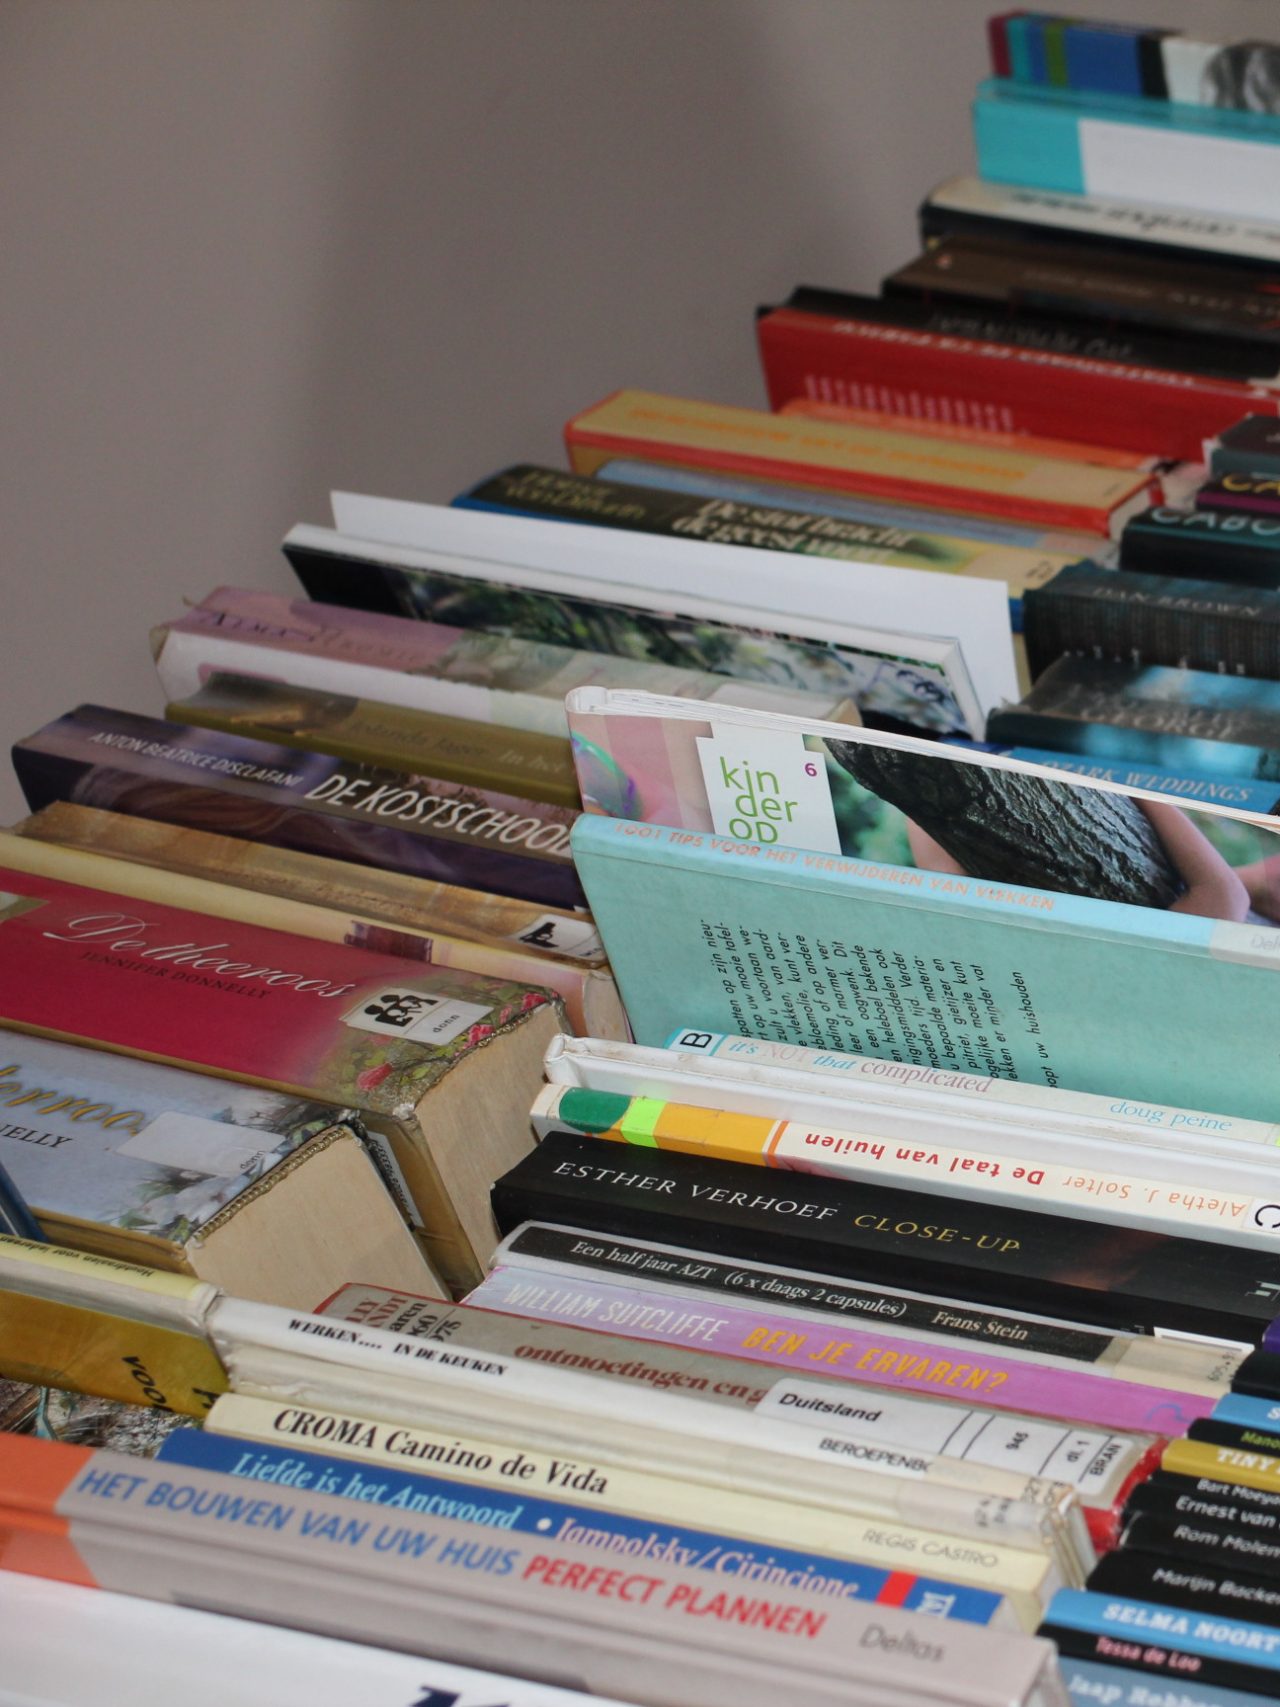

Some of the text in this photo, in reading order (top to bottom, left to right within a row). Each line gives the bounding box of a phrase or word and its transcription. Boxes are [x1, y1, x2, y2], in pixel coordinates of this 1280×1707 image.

[304, 774, 366, 801] DE
[719, 755, 780, 795] kin
[803, 761, 819, 779] 6
[734, 792, 798, 823] der
[80, 950, 271, 1000] JENNIFER DONNELLY
[748, 953, 772, 1002] voortaan
[950, 961, 983, 1028] moeite kunt
[978, 987, 1000, 1026] minder
[1010, 972, 1041, 1035] huishouden
[678, 1031, 714, 1049] B
[727, 1038, 1233, 1134] it's NOT that complicated doug peine
[804, 1130, 885, 1161] huilen
[896, 1149, 941, 1170] van
[950, 1157, 1001, 1180] taal
[1013, 1167, 1045, 1188] De
[1061, 1172, 1132, 1200] Solter
[553, 1160, 1021, 1253] ESTHER VERHOEF CLOSE-UP
[1167, 1189, 1247, 1218] Aletha
[569, 1240, 1029, 1343] Een half jaar AZT (6 x daags 2 capsules) Frans Stein
[287, 1319, 508, 1376] WERKEN.... IN DE KEUKEN
[503, 1283, 1009, 1394] WILLIAM SUTCLIFFE BEN JE ERVAREN?
[513, 1341, 712, 1390] ontmoetingen
[778, 1391, 882, 1424] Duitsland
[272, 1408, 609, 1494] CROMA Camino de Vida
[229, 1452, 312, 1492] Liefde
[313, 1471, 341, 1496] is
[346, 1476, 389, 1507] het
[383, 1487, 524, 1531] Antwoord
[77, 1469, 945, 1664] HET BOUWEN VAN UW HUIS PERFECT PLANNEN Deltas
[862, 1528, 999, 1568] REGIS CASTRO
